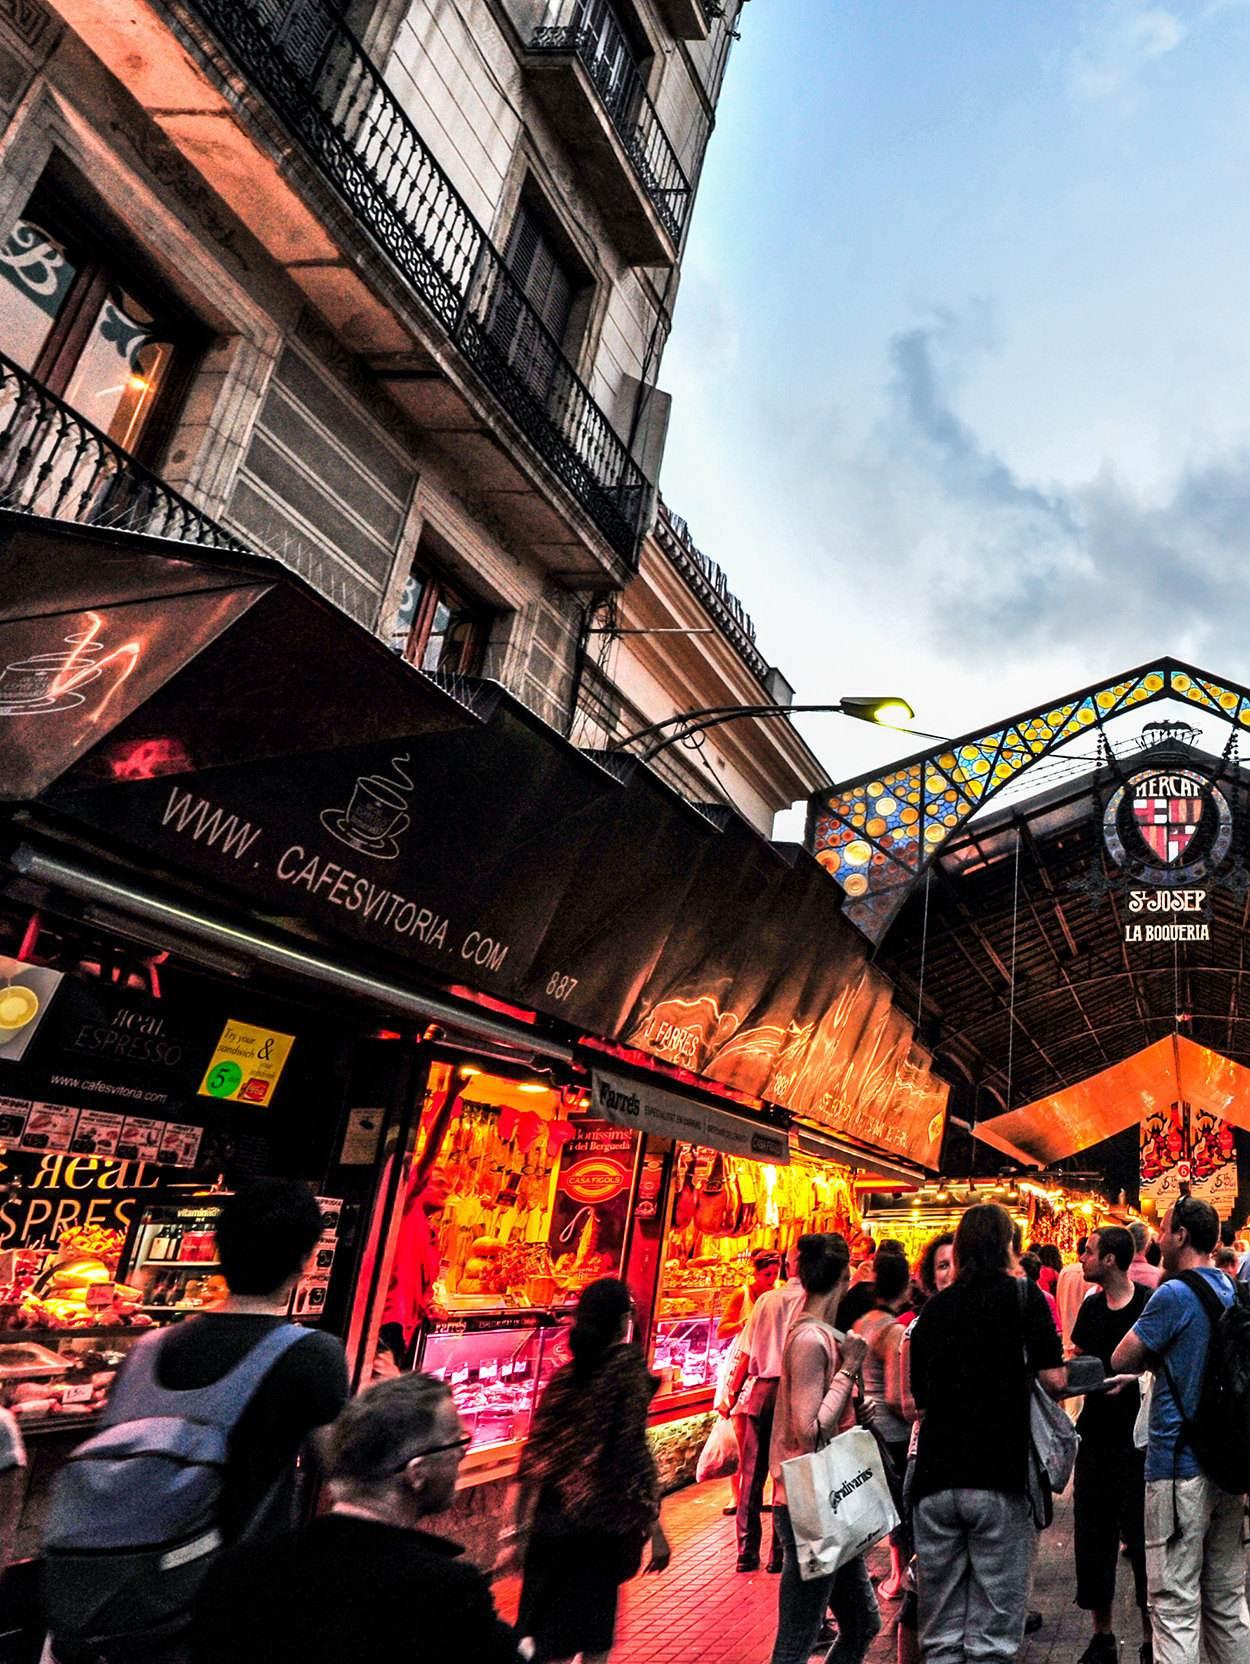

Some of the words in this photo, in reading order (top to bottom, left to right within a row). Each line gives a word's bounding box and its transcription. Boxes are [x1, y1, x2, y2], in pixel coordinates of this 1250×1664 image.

[1135, 776, 1201, 798] MERCAT
[1146, 890, 1207, 912] JOSEP
[1125, 924, 1143, 942] LA
[1145, 923, 1210, 942] BOQUERIA
[546, 971, 578, 1001] 887
[74, 1024, 182, 1066] ESPRESSO
[50, 1074, 169, 1105] www.cafesvitoria.com
[600, 1081, 641, 1117] Farrés
[591, 1176, 621, 1184] FIGOLS
